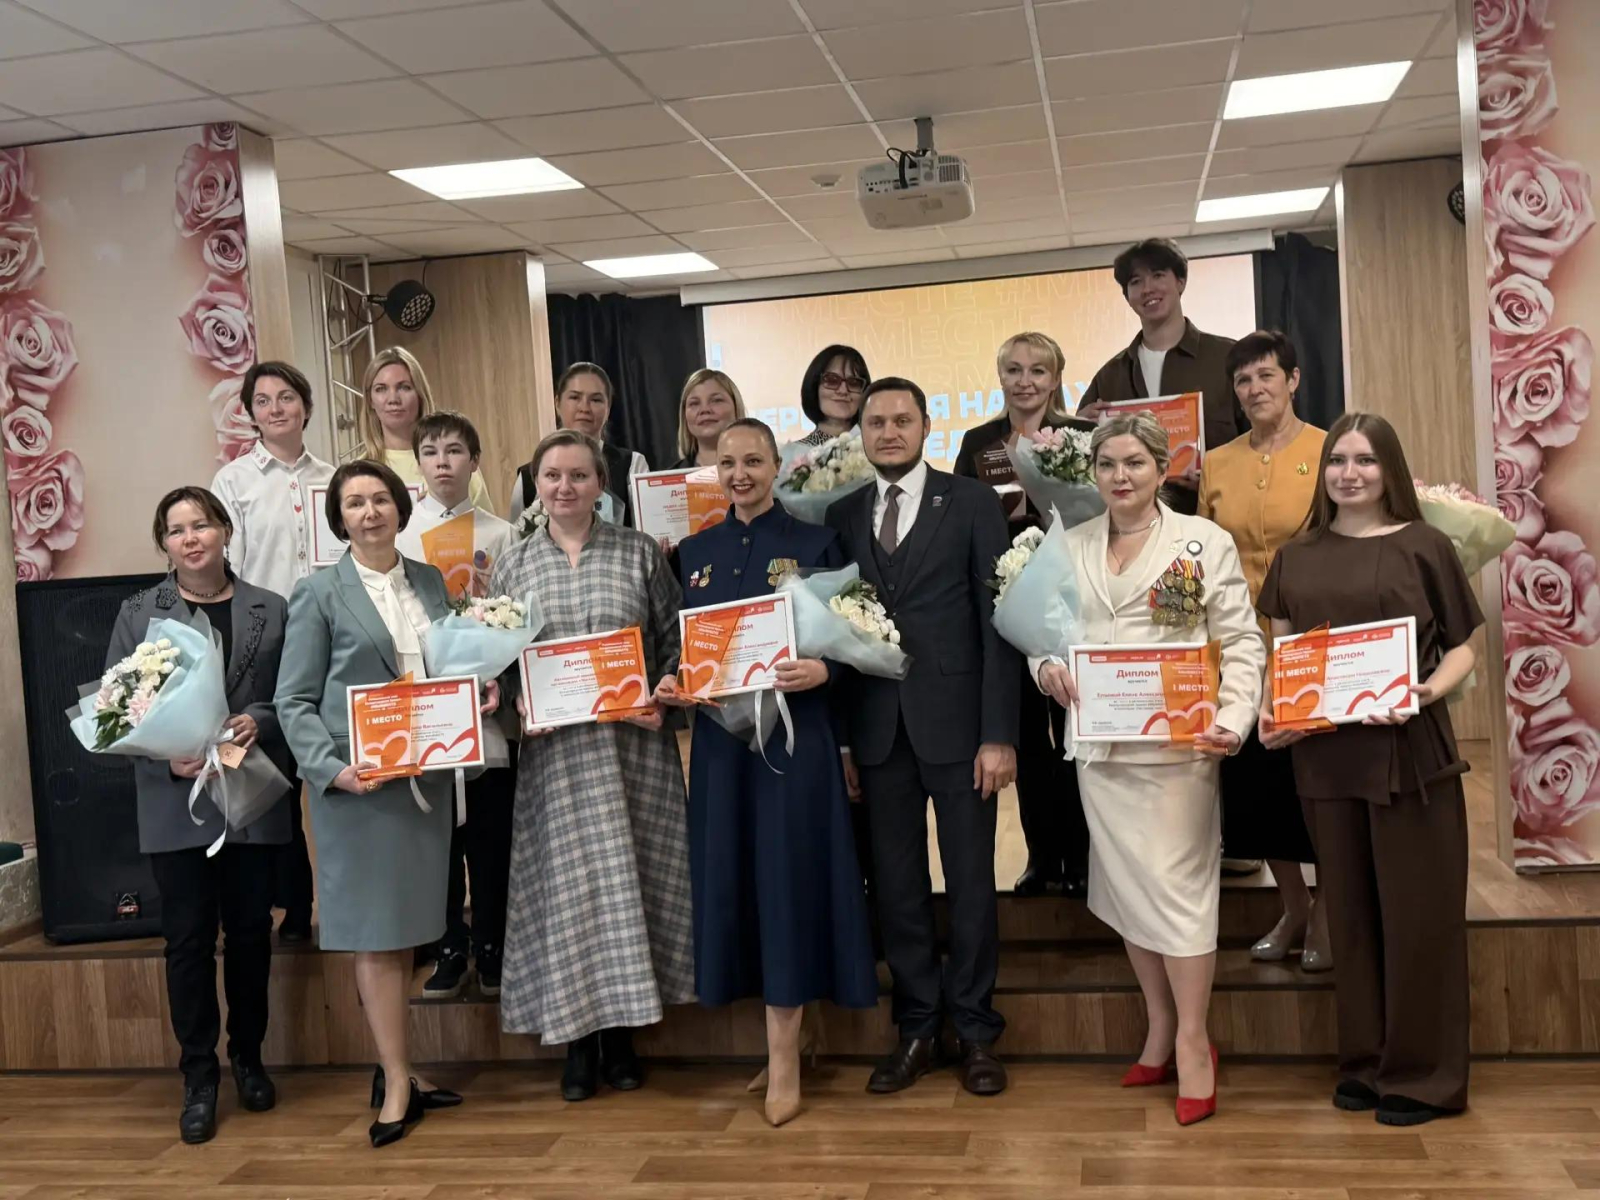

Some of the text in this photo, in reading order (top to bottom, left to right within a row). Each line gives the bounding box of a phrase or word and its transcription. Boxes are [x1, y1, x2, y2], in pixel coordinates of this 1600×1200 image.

[991, 467, 1012, 475] МЕСТ
[693, 640, 719, 652] МЕСТО
[606, 659, 636, 669] МЕСТО
[1116, 669, 1159, 679] Диплом
[1286, 666, 1319, 677] МЕСТО
[1178, 684, 1210, 692] МЕСТО
[372, 714, 403, 725] МЕСТО
